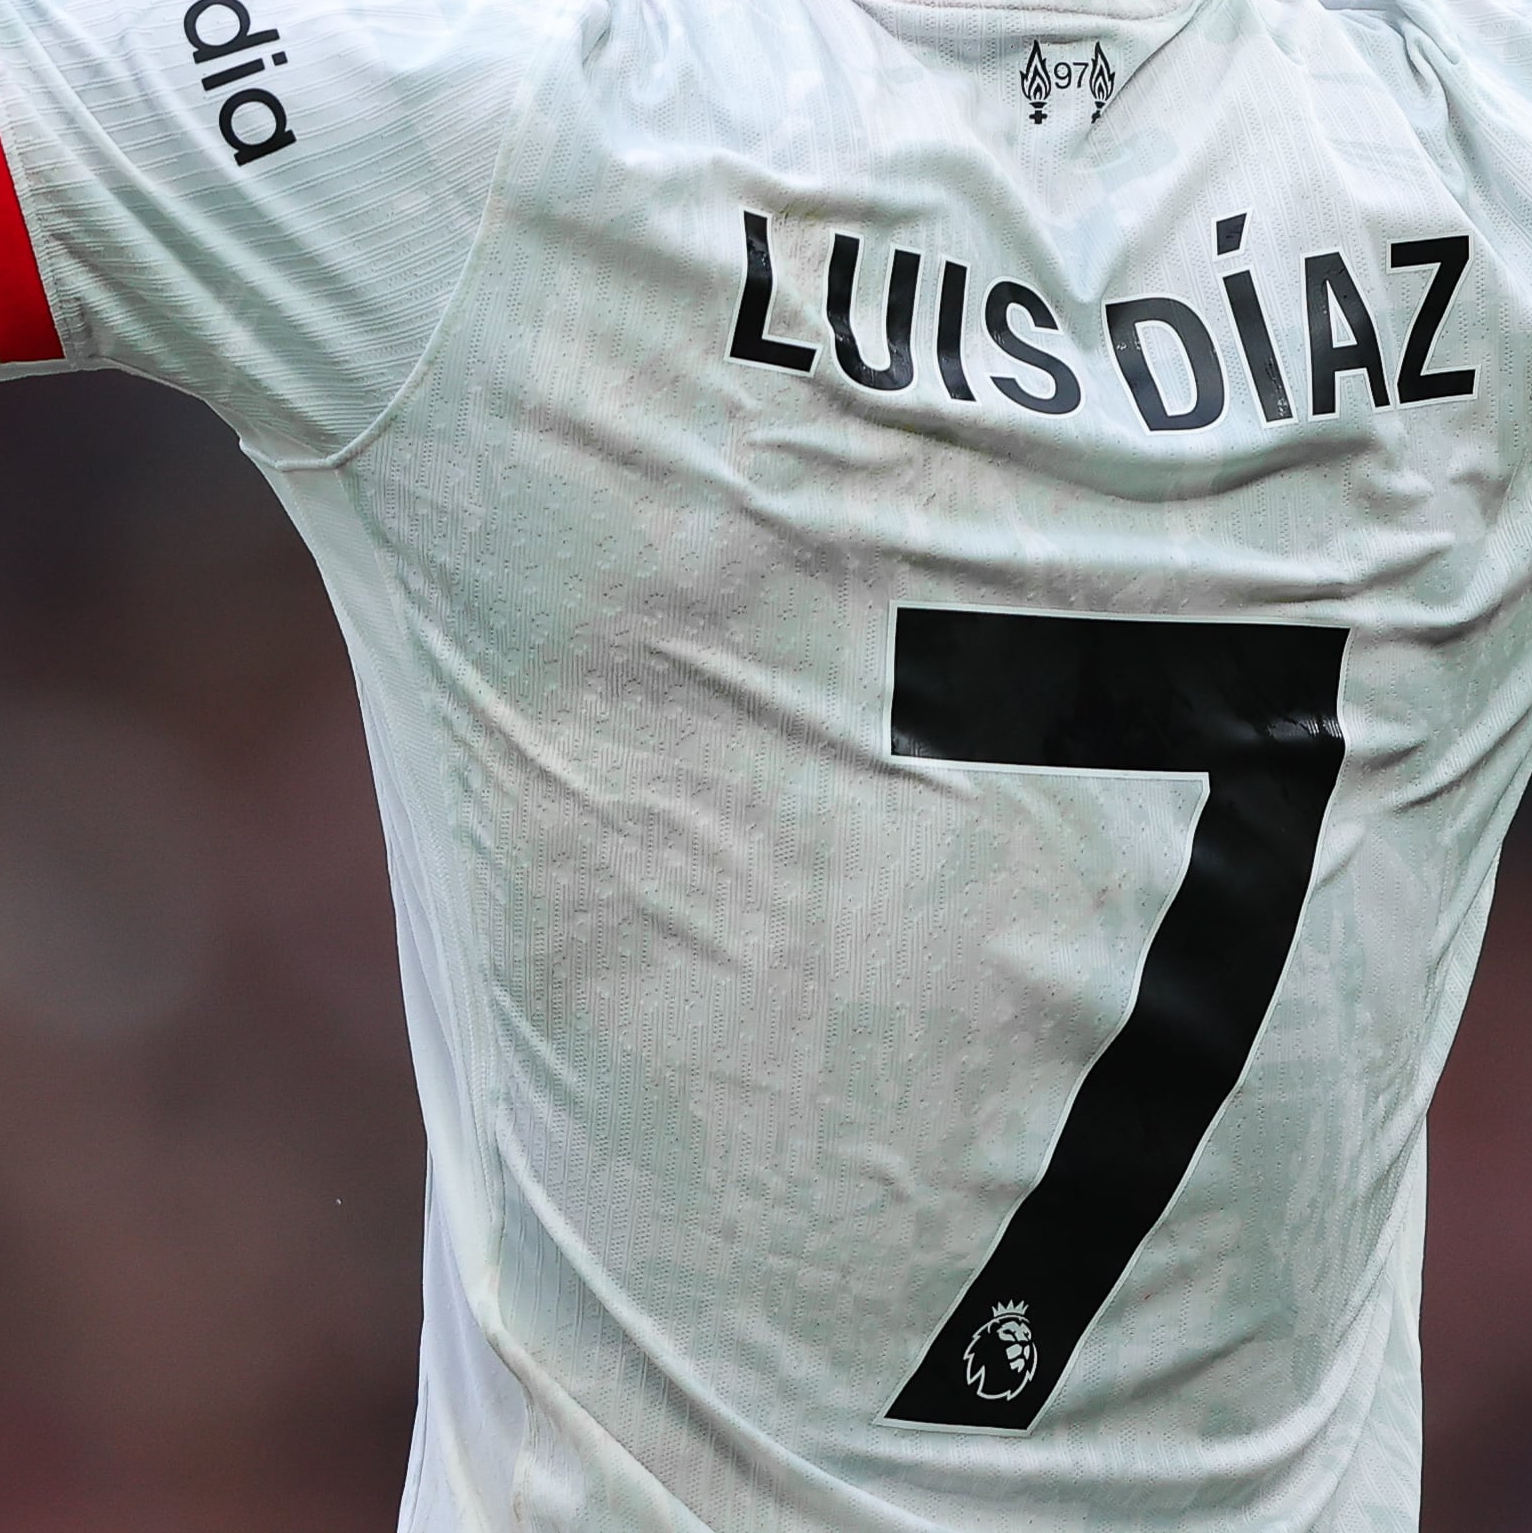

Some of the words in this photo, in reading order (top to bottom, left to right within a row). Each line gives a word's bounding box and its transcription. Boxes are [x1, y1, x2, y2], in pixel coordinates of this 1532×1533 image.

[1053, 61, 1089, 90] 97
[728, 210, 1082, 418] LUIS
[1104, 211, 1479, 433] DÍAZ
[877, 604, 1352, 1433] 7
